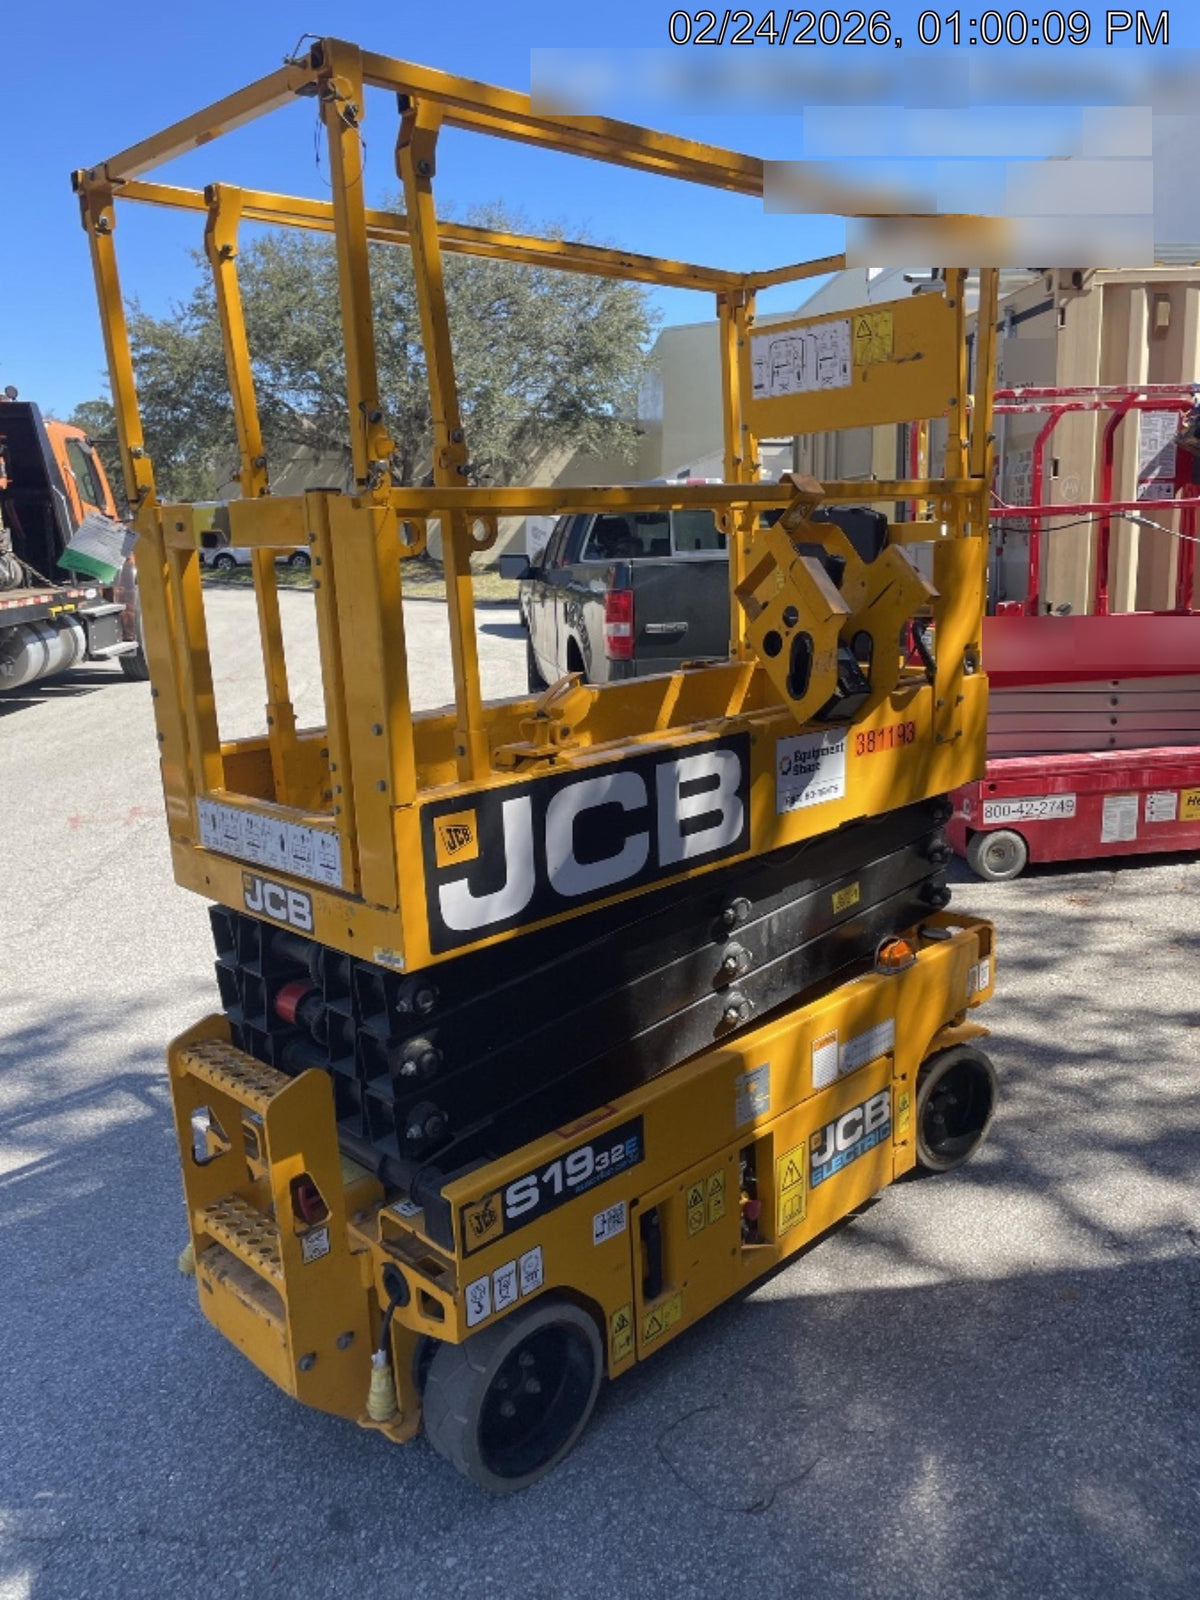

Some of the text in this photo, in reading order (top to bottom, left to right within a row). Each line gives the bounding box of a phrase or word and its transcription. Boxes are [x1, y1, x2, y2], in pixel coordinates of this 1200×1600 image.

[856, 721, 916, 756] 381193
[439, 750, 744, 931] JCB
[444, 825, 472, 852] JCB
[244, 878, 312, 931] JCB
[812, 1090, 890, 1167] JCB
[812, 1122, 890, 1187] ELECTRIC
